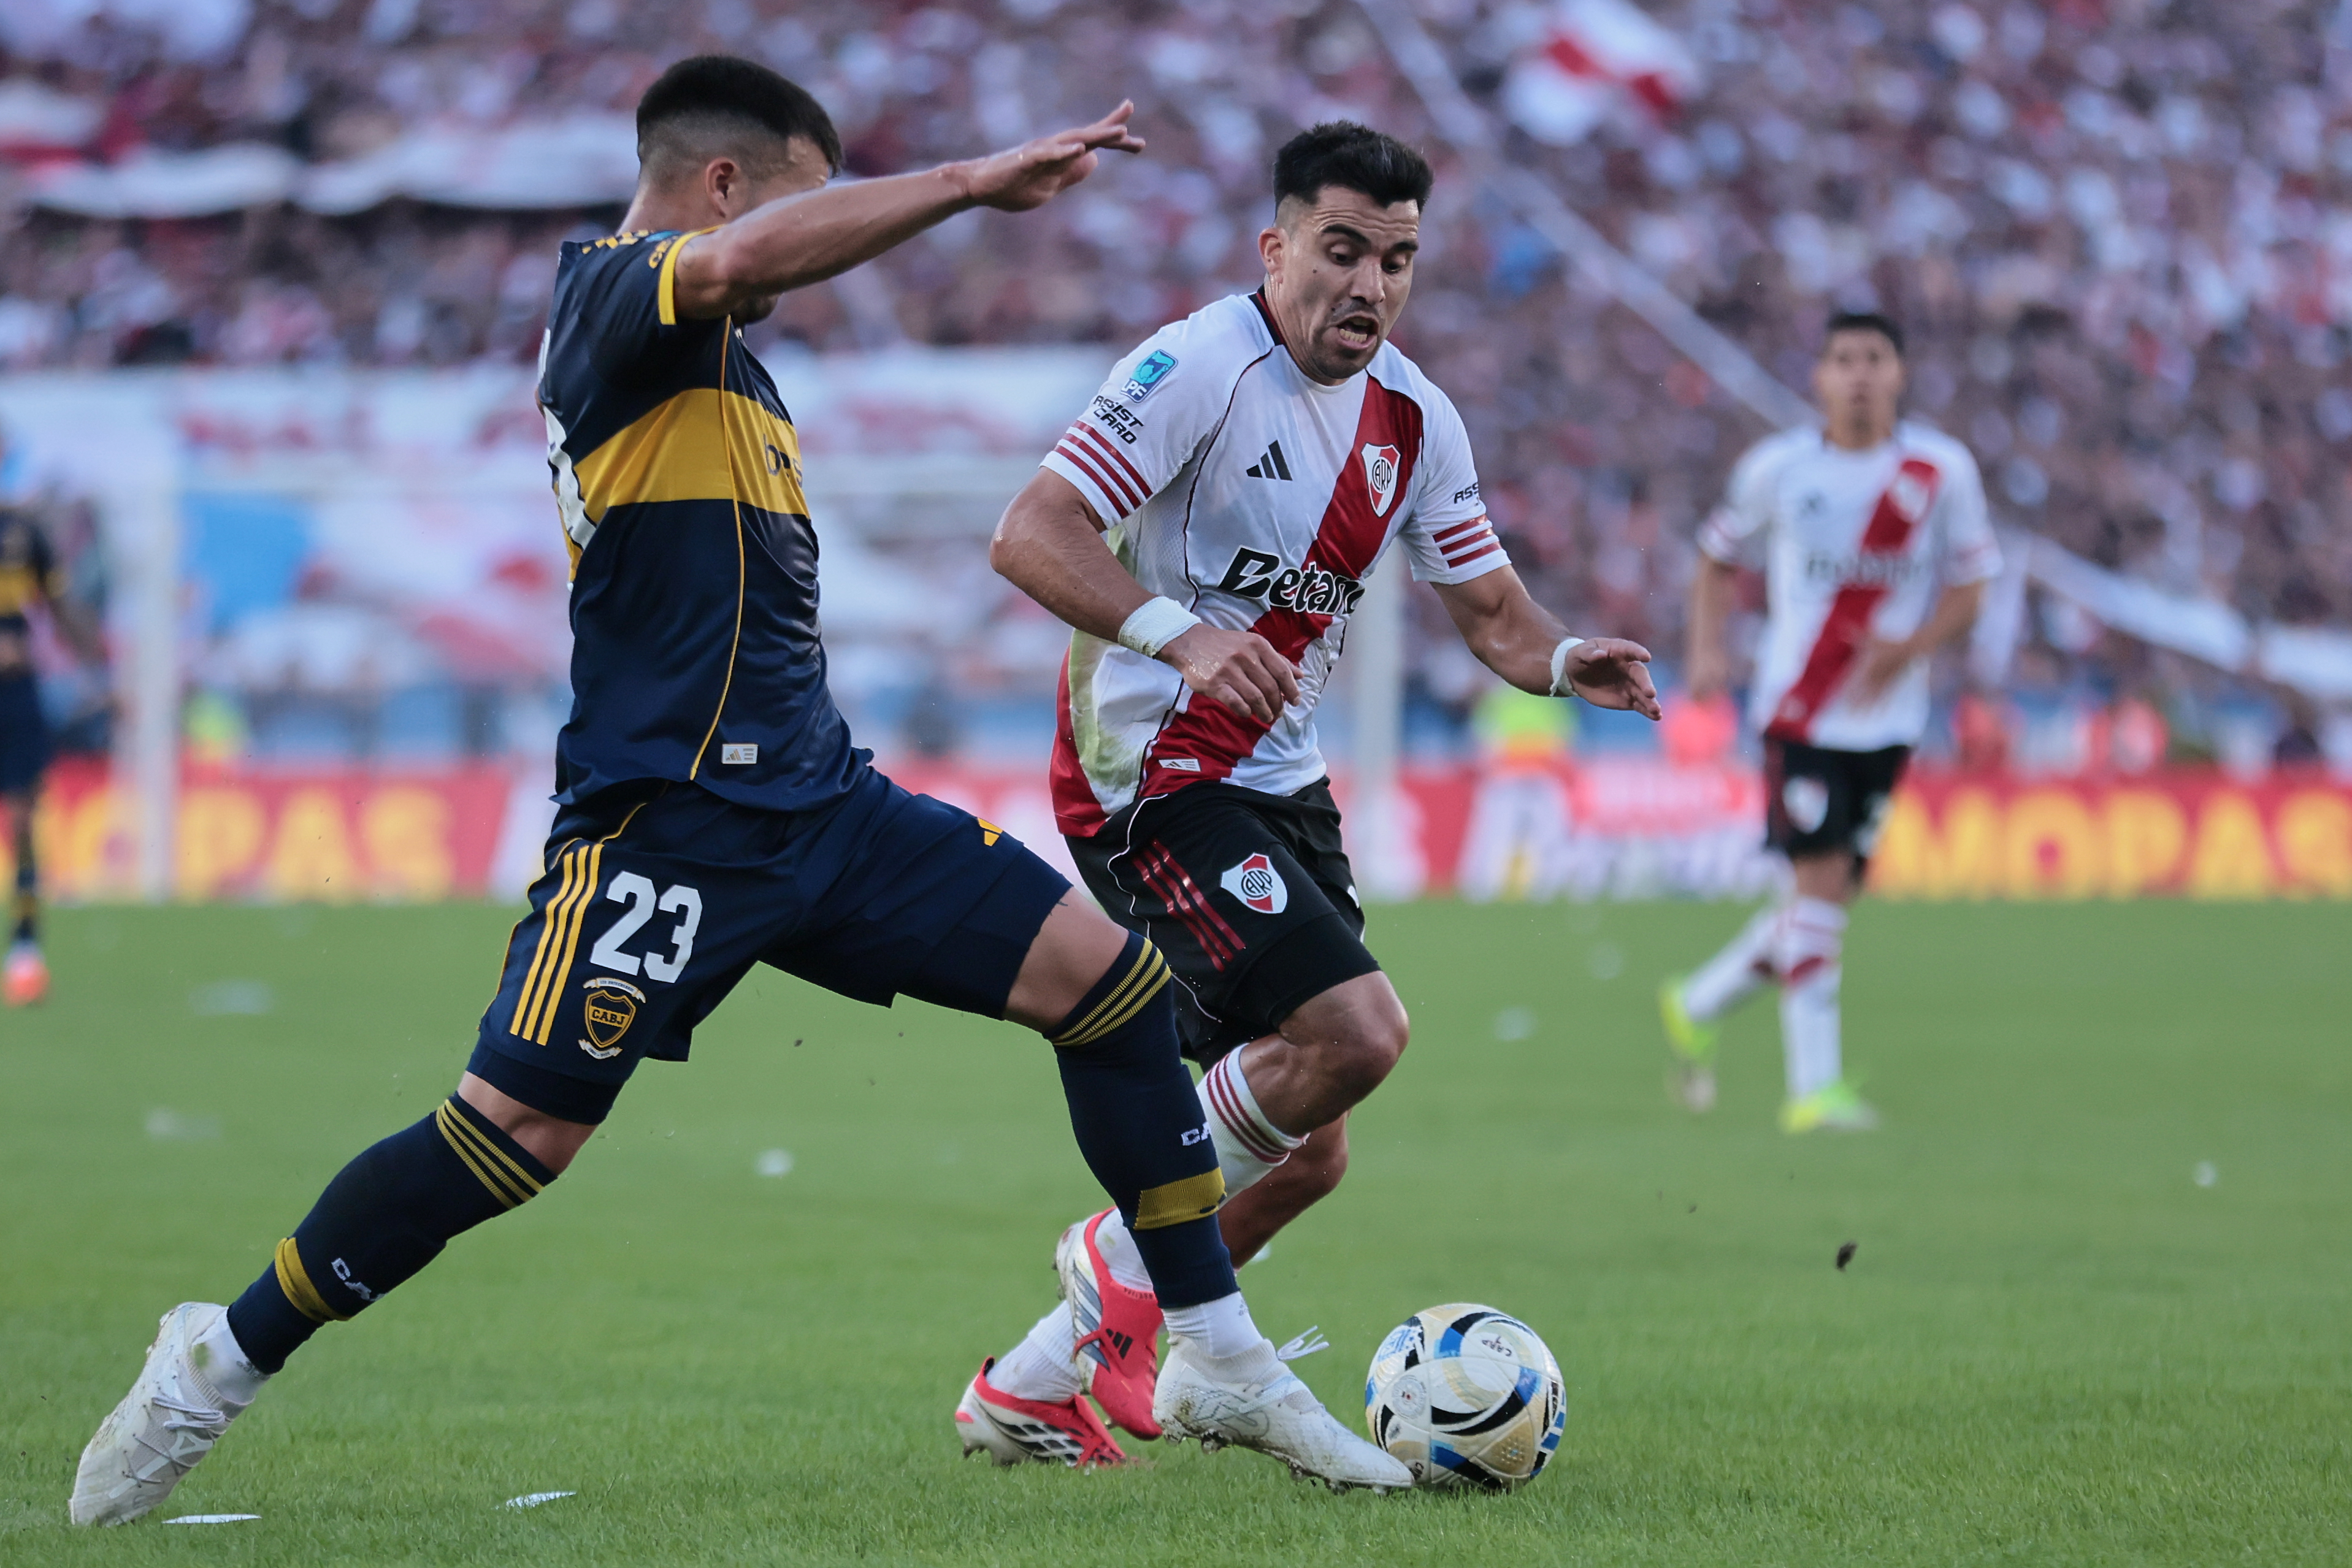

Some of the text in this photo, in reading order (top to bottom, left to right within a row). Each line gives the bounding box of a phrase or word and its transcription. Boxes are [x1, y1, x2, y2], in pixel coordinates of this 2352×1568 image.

[1120, 378, 1147, 398] LPF
[1094, 408, 1137, 445] CARD
[1371, 459, 1392, 492] CARP
[1241, 870, 1273, 898] CARP
[589, 870, 703, 984] 23
[592, 1009, 626, 1025] CABJ
